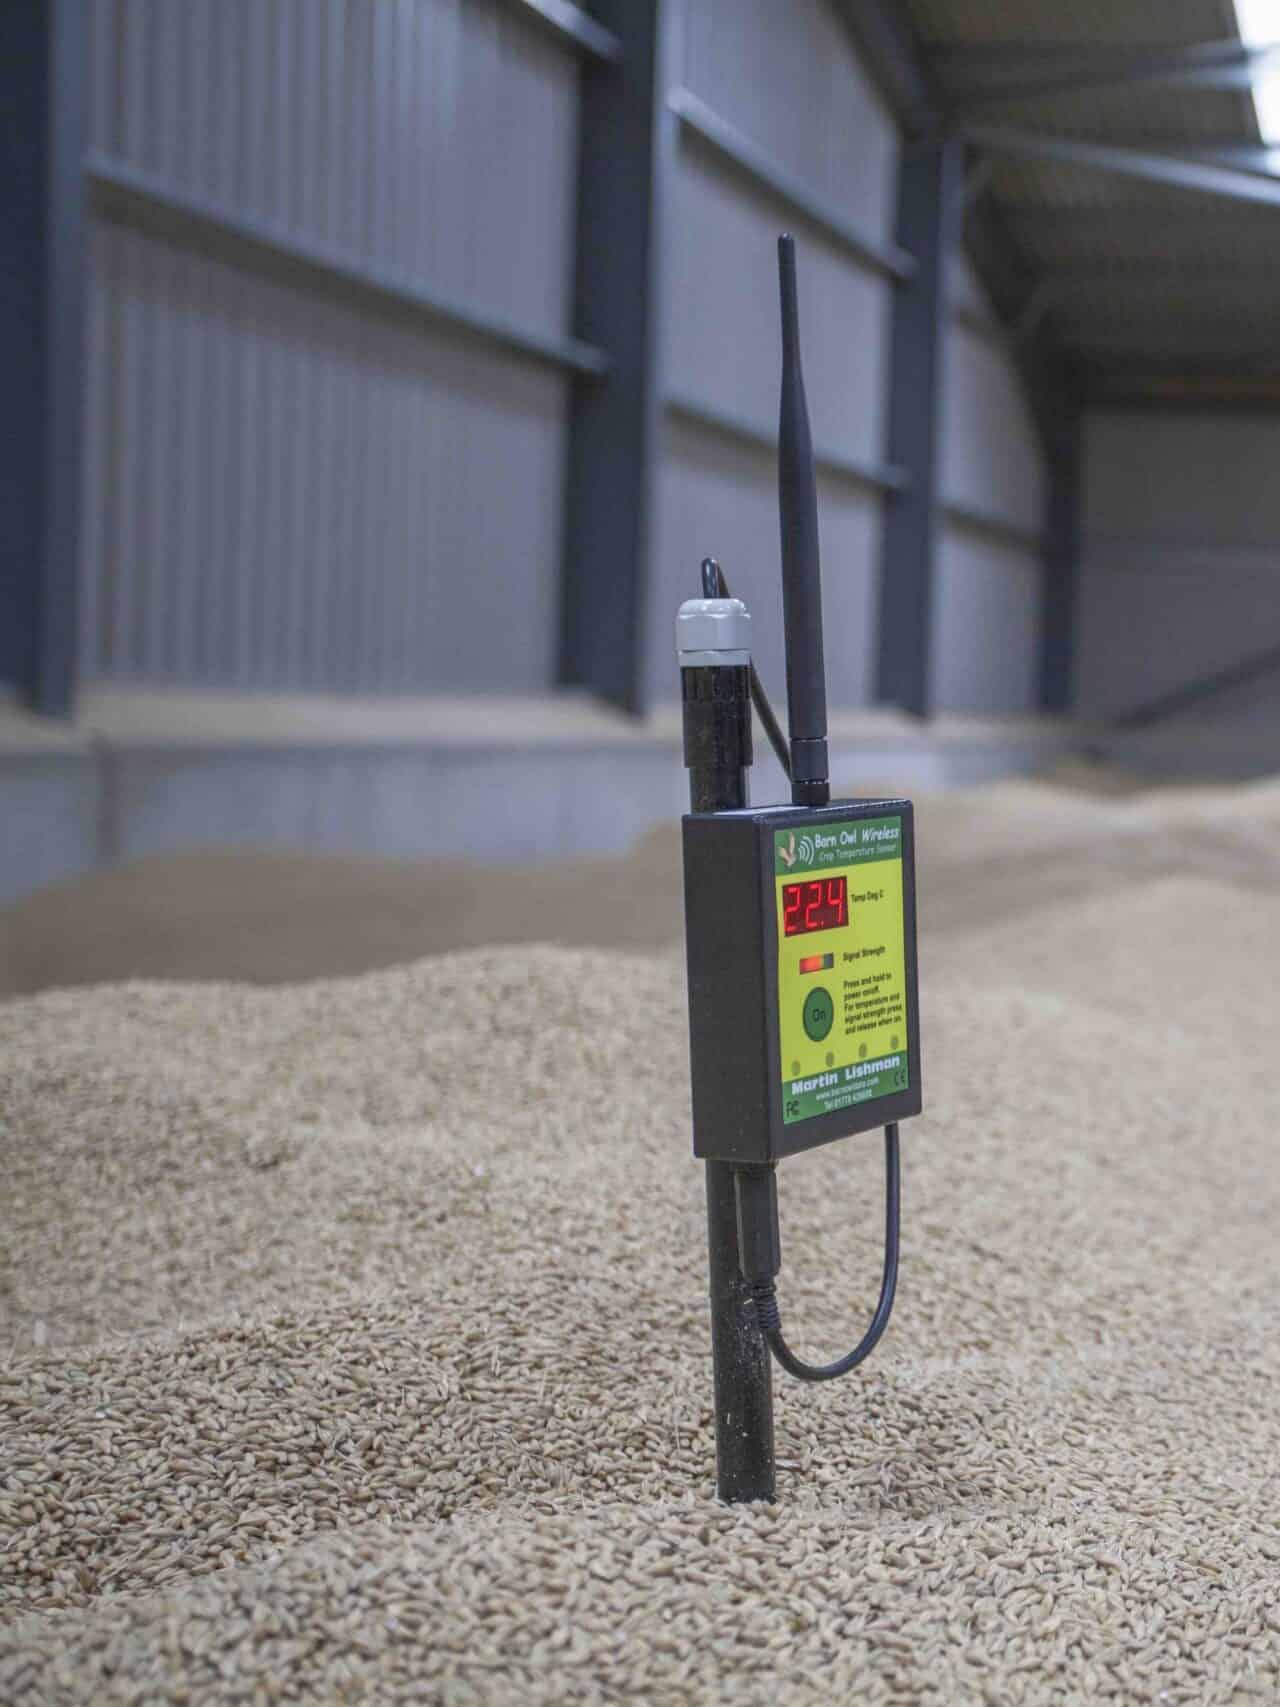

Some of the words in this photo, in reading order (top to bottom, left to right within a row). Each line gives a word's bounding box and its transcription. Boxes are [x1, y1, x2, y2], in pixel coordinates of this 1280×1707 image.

[840, 829, 857, 845] Owl
[862, 825, 900, 843] Wireless
[867, 891, 879, 901] Deg
[843, 951, 860, 963] Signal
[862, 946, 886, 958] Strength
[843, 980, 860, 988] Press
[861, 976, 872, 985] and
[873, 972, 885, 982] hold
[844, 992, 861, 1002] power
[844, 1003, 854, 1012] For
[855, 997, 889, 1009] temperature
[889, 992, 900, 1001] and
[812, 1008, 826, 1022] On
[844, 1013, 861, 1024] signal
[863, 1007, 886, 1019] strength
[845, 1025, 856, 1035] and
[857, 1021, 877, 1031] release
[878, 1017, 892, 1027] when
[791, 1072, 839, 1095] Martin
[845, 1055, 900, 1081] Lishman
